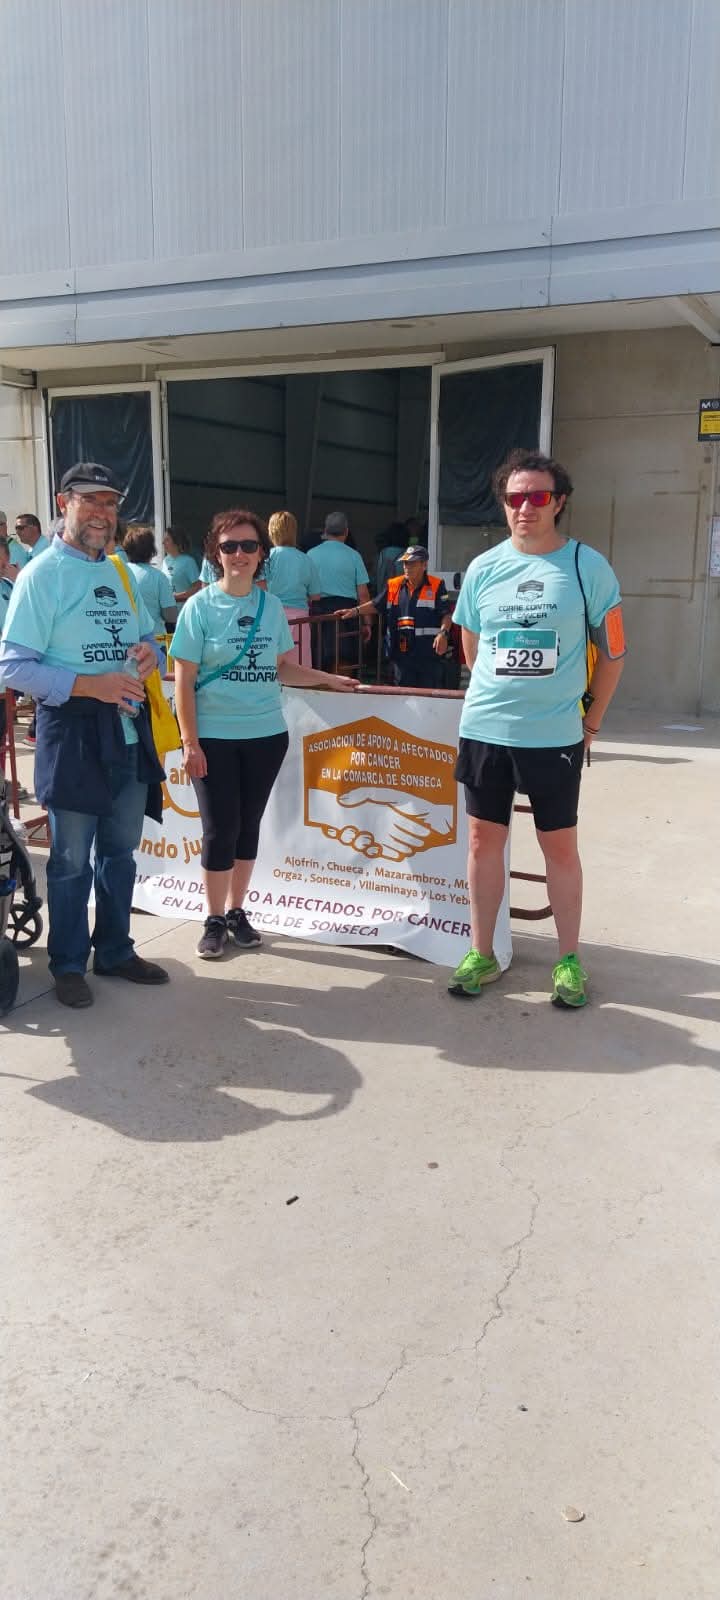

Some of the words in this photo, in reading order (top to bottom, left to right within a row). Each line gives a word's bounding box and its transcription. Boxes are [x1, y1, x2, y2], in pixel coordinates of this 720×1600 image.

[499, 604, 524, 612] CORRE
[525, 603, 558, 611] CONTRA
[506, 649, 544, 668] 529
[350, 751, 366, 766] POR
[356, 733, 366, 747] DE
[367, 733, 392, 752] APOYO
[393, 739, 399, 753] A
[401, 742, 454, 764] AFECTADOS
[321, 767, 332, 779] EN
[332, 768, 342, 781] LA
[343, 769, 384, 785] COMARCA
[385, 773, 399, 786] DE
[400, 774, 442, 788] SONSECA
[273, 868, 303, 882] Orgaz
[310, 873, 351, 888] Sonseca
[359, 879, 418, 898] Villaminaya
[429, 890, 447, 902] Los
[327, 861, 364, 875] Chueca
[374, 867, 446, 886] Mazarambroz
[161, 896, 184, 908] EN
[184, 900, 204, 913] LA
[283, 916, 305, 929] DE
[309, 919, 379, 937] SONSECA
[262, 892, 273, 905] A
[276, 894, 366, 918] AFECTADOS
[371, 908, 404, 923] POR
[407, 912, 472, 938] CÁNCER
